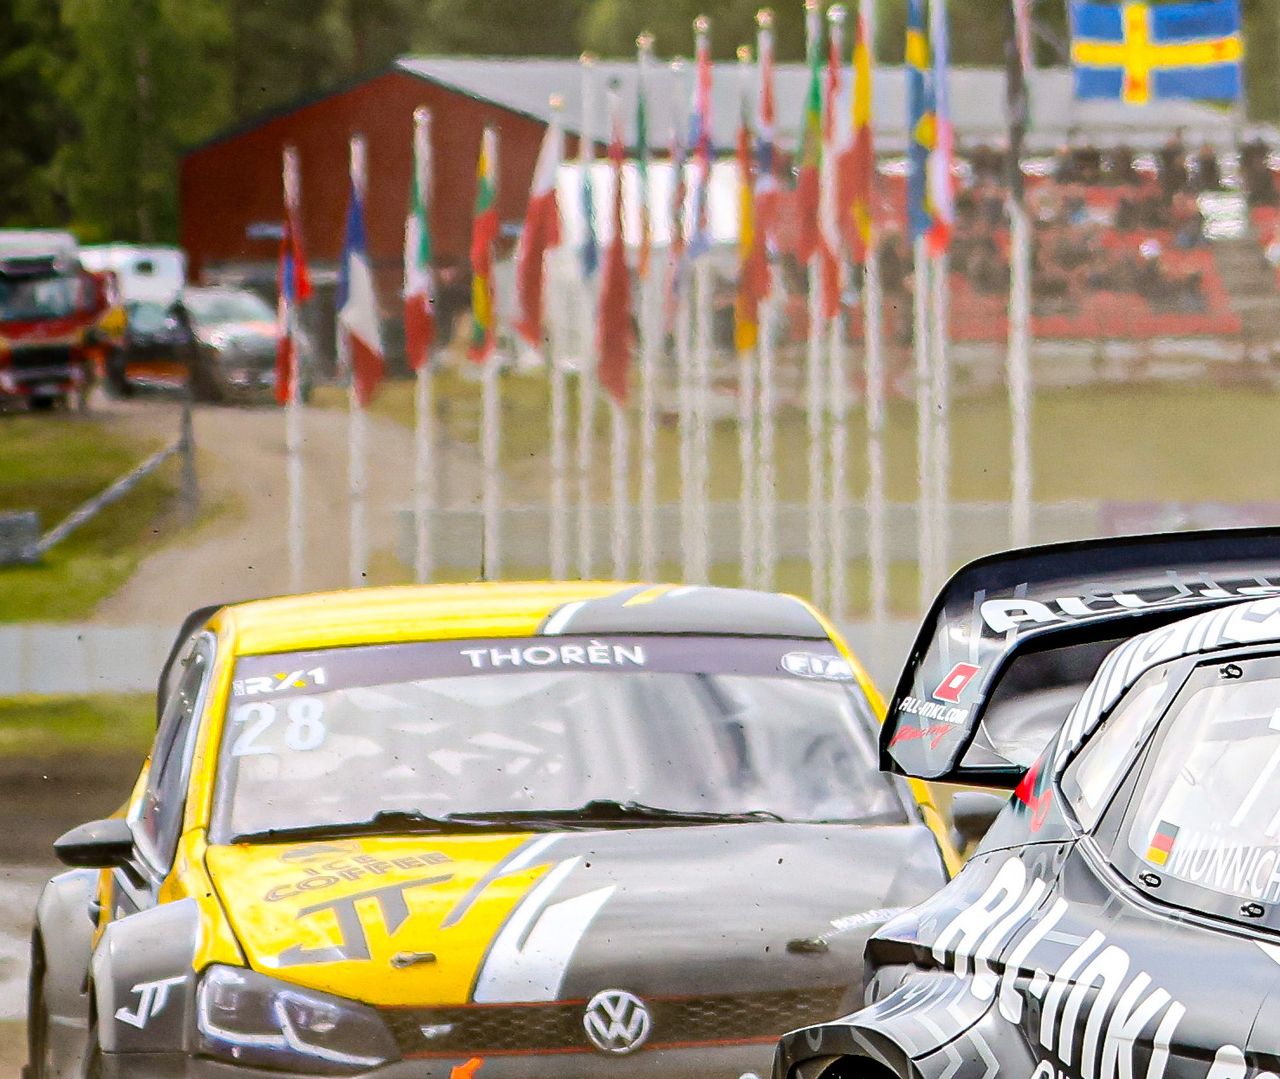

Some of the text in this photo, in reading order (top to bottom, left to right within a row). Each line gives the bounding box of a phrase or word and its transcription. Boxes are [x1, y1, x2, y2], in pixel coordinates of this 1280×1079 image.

[460, 640, 646, 667] THORÈN
[231, 697, 326, 756] 28
[264, 852, 454, 902] COFFEE
